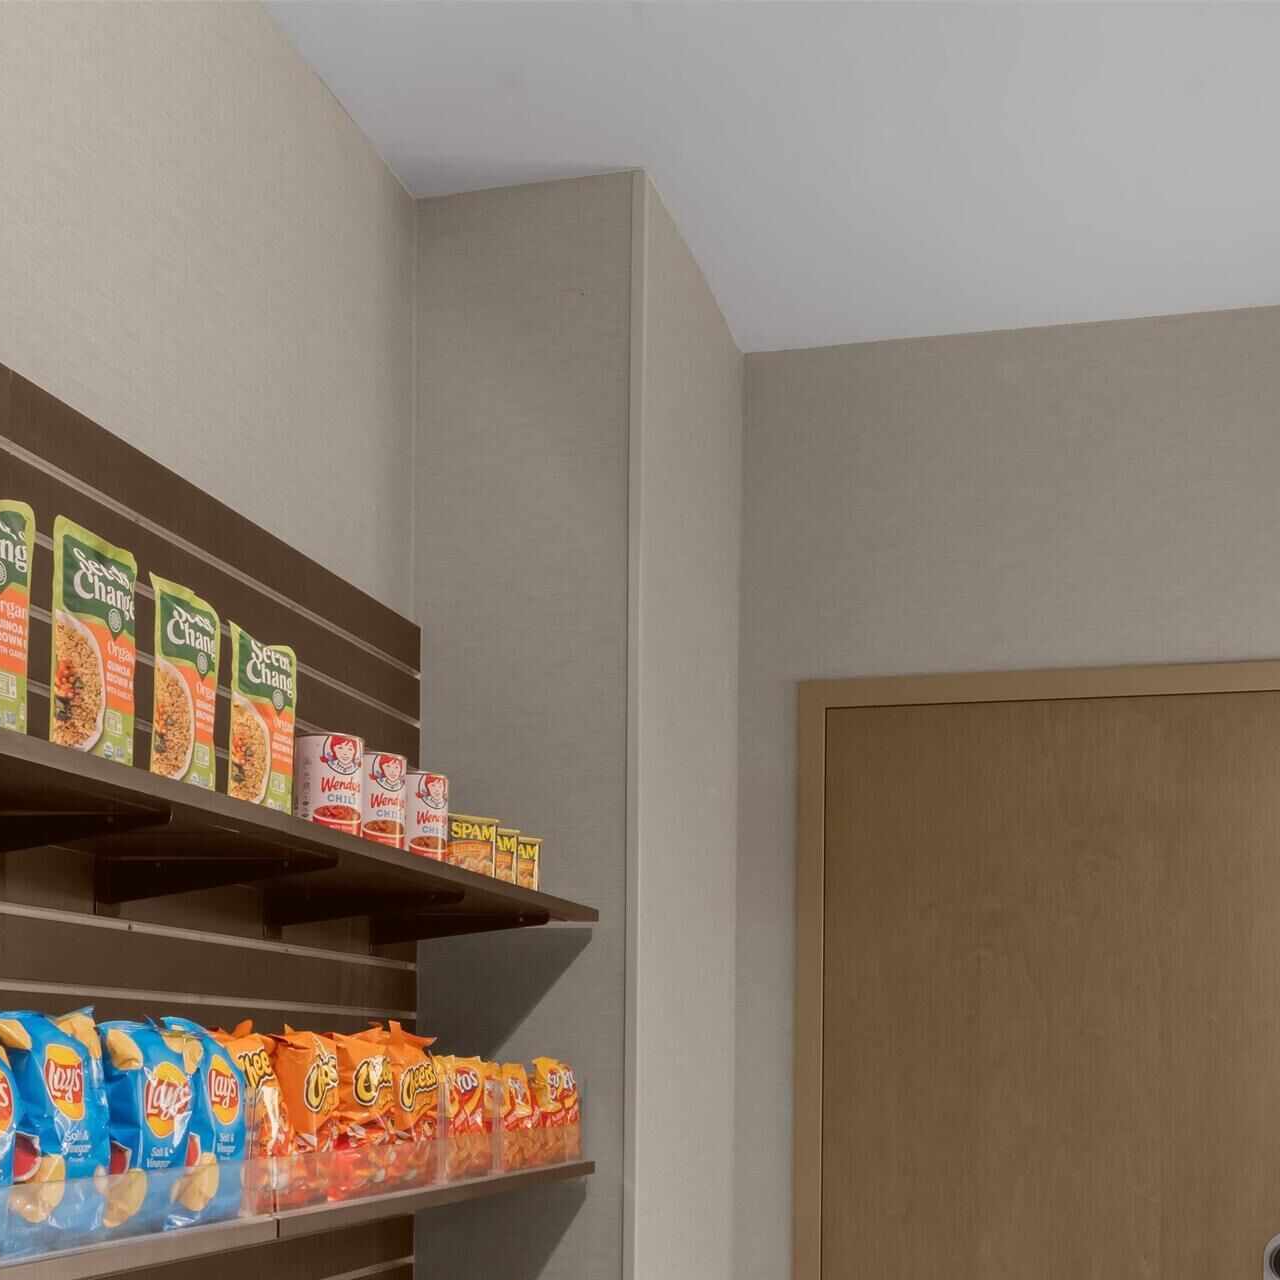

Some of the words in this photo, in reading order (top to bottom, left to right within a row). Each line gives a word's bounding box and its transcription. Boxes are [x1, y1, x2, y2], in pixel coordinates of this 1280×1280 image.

[321, 776, 361, 797] Wendy's
[451, 822, 494, 841] SPAM
[48, 1059, 81, 1103] Lay's
[211, 1073, 236, 1108] Lay's
